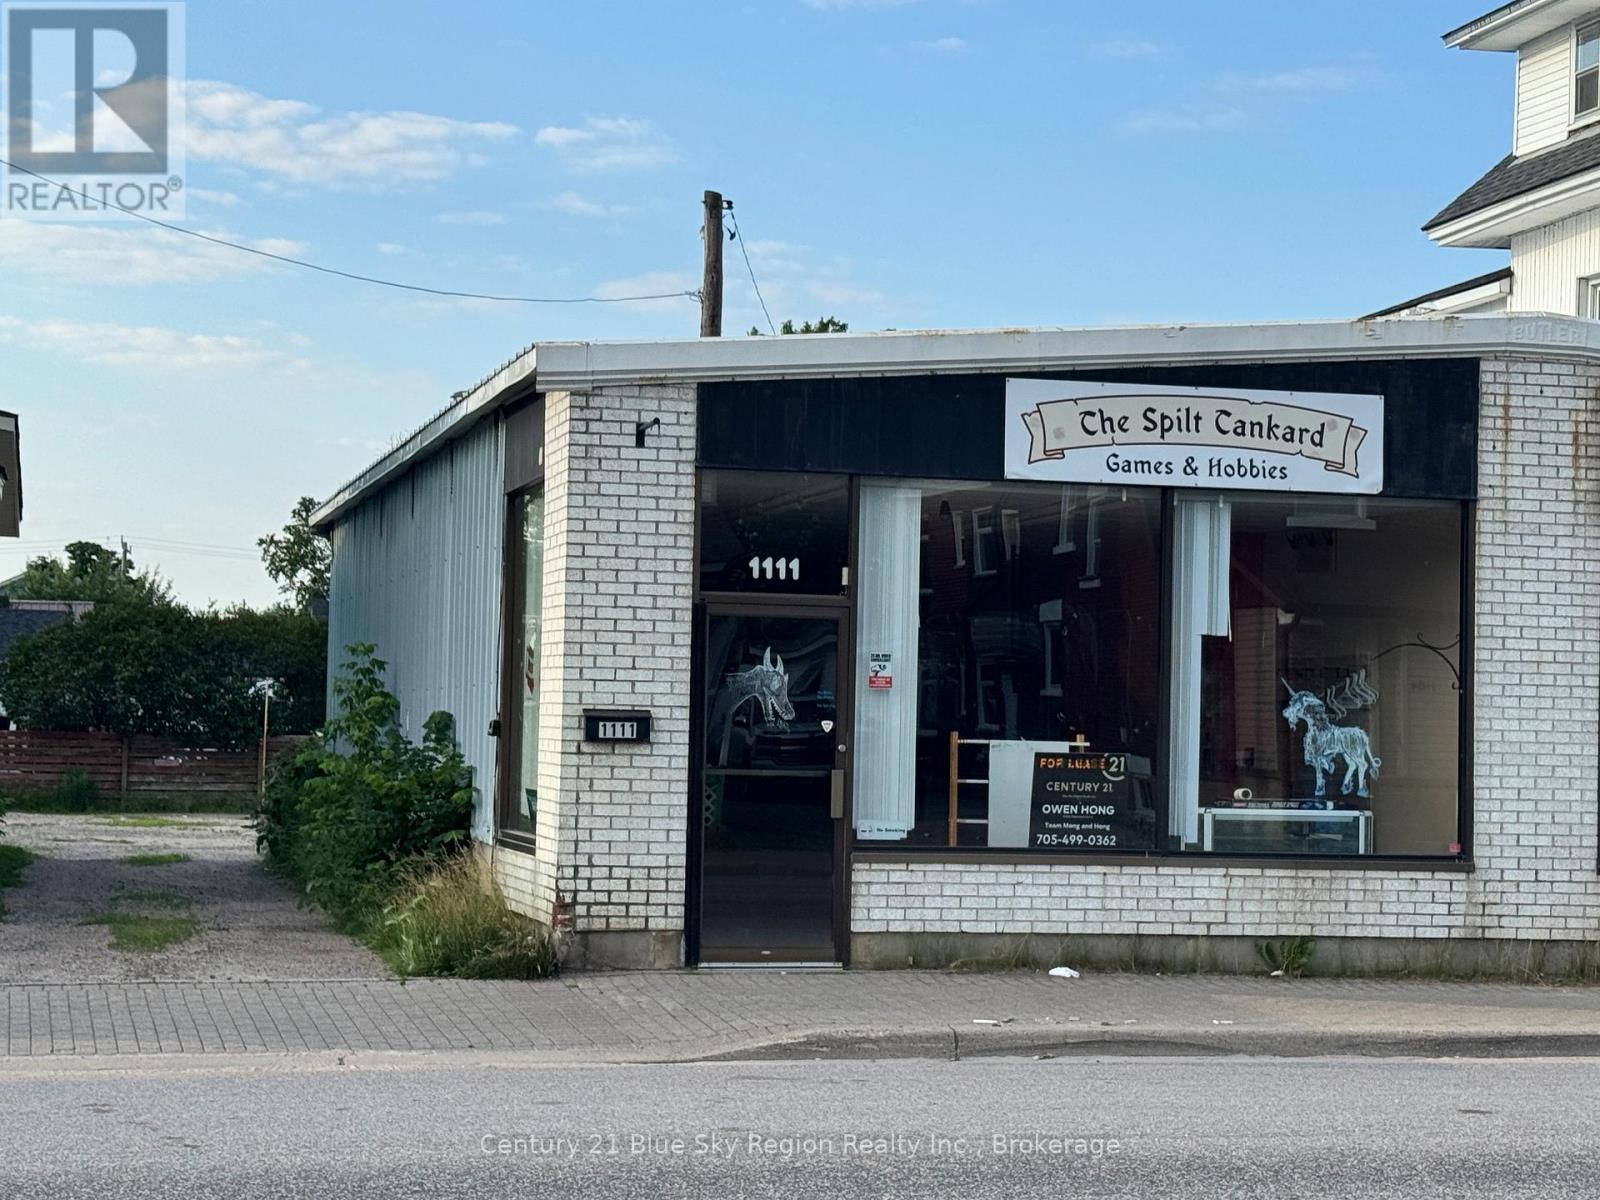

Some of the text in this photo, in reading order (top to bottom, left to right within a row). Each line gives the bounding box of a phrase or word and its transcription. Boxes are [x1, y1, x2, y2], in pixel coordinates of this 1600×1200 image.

[1513, 321, 1587, 345] BUTLER
[1079, 406, 1327, 448] The Spilt Tankard
[1106, 453, 1288, 480] Games & Hobbies
[748, 556, 800, 581] 1111
[601, 722, 635, 738] 1111
[1108, 757, 1125, 772] 21
[1046, 782, 1113, 792] CENTURY 21
[1042, 804, 1115, 815] OWEN HONG
[1036, 834, 1116, 846] 705-499-0362
